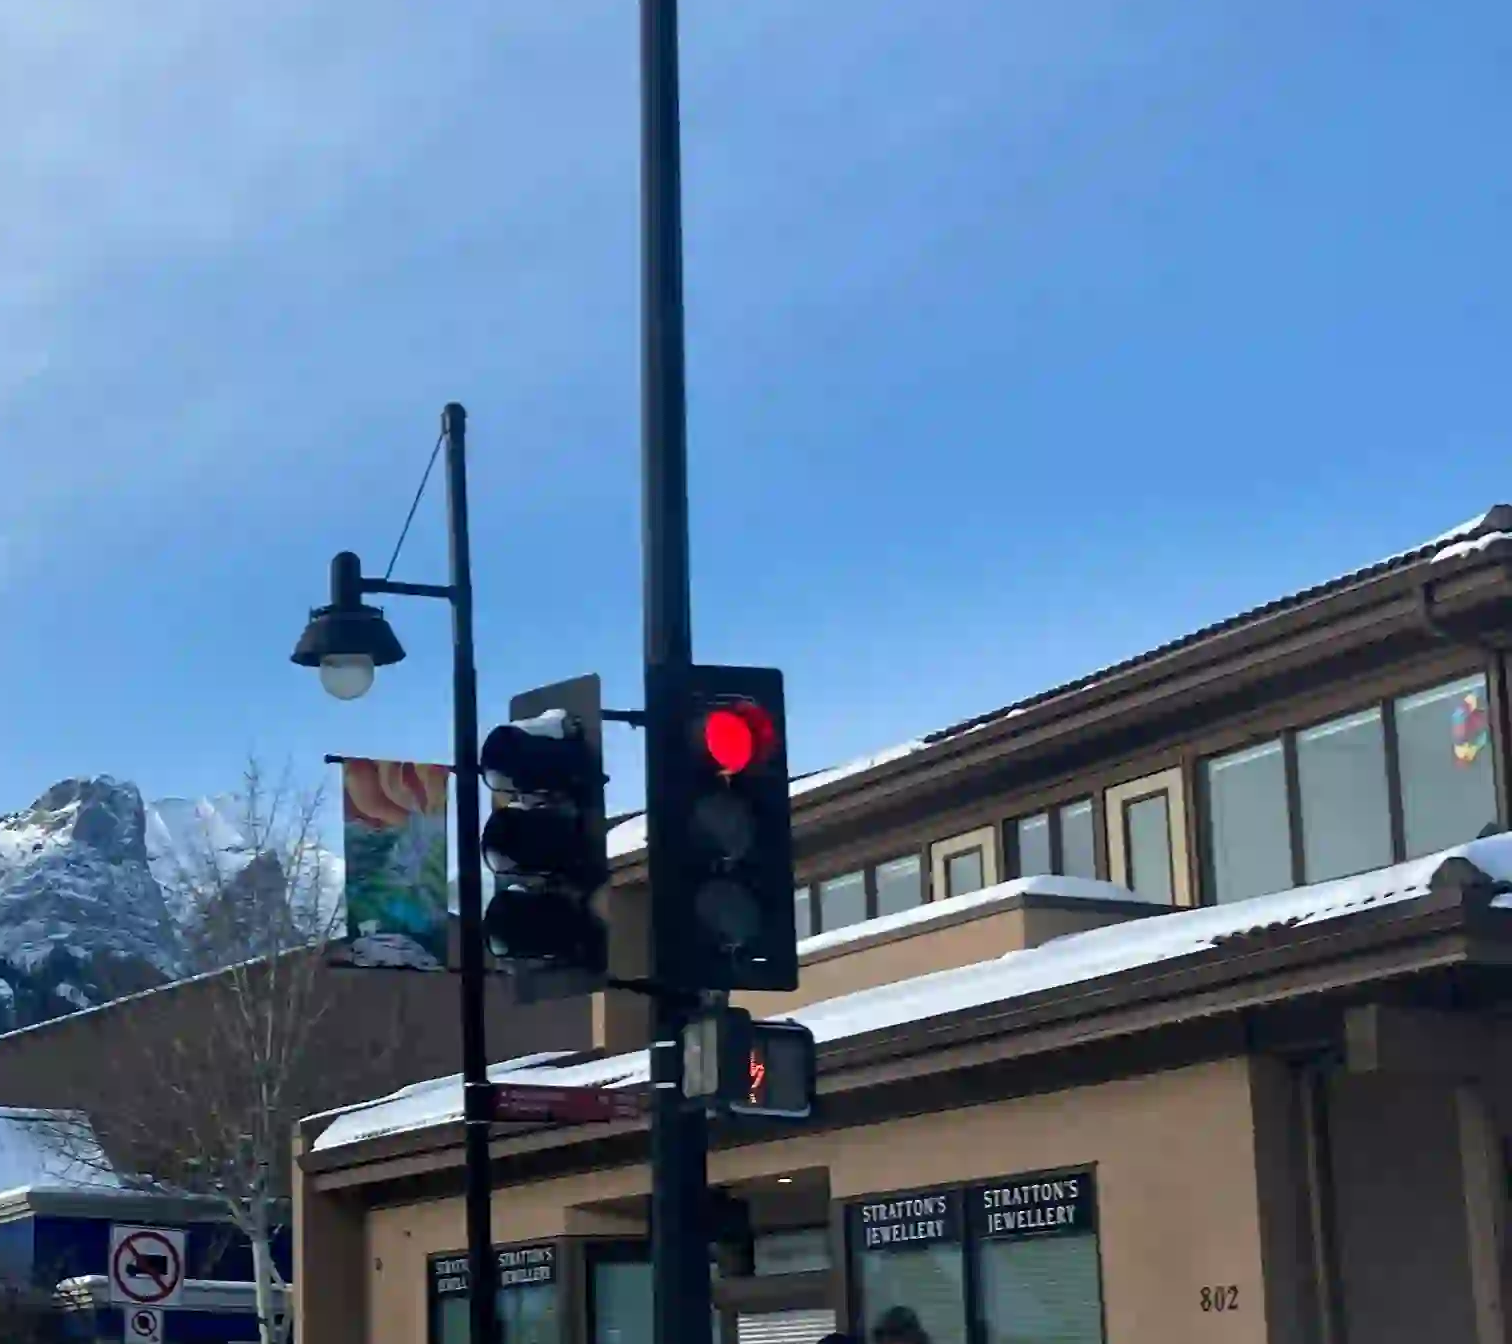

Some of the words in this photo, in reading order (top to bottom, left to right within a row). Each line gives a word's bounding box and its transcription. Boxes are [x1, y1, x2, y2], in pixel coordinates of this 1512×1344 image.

[983, 1179, 1079, 1208] STRATTON'S
[863, 1196, 947, 1223] STRATTON'S
[988, 1205, 1076, 1233] JEWELLERY
[866, 1220, 944, 1247] JEWELLERY
[1200, 1285, 1239, 1312] 802
